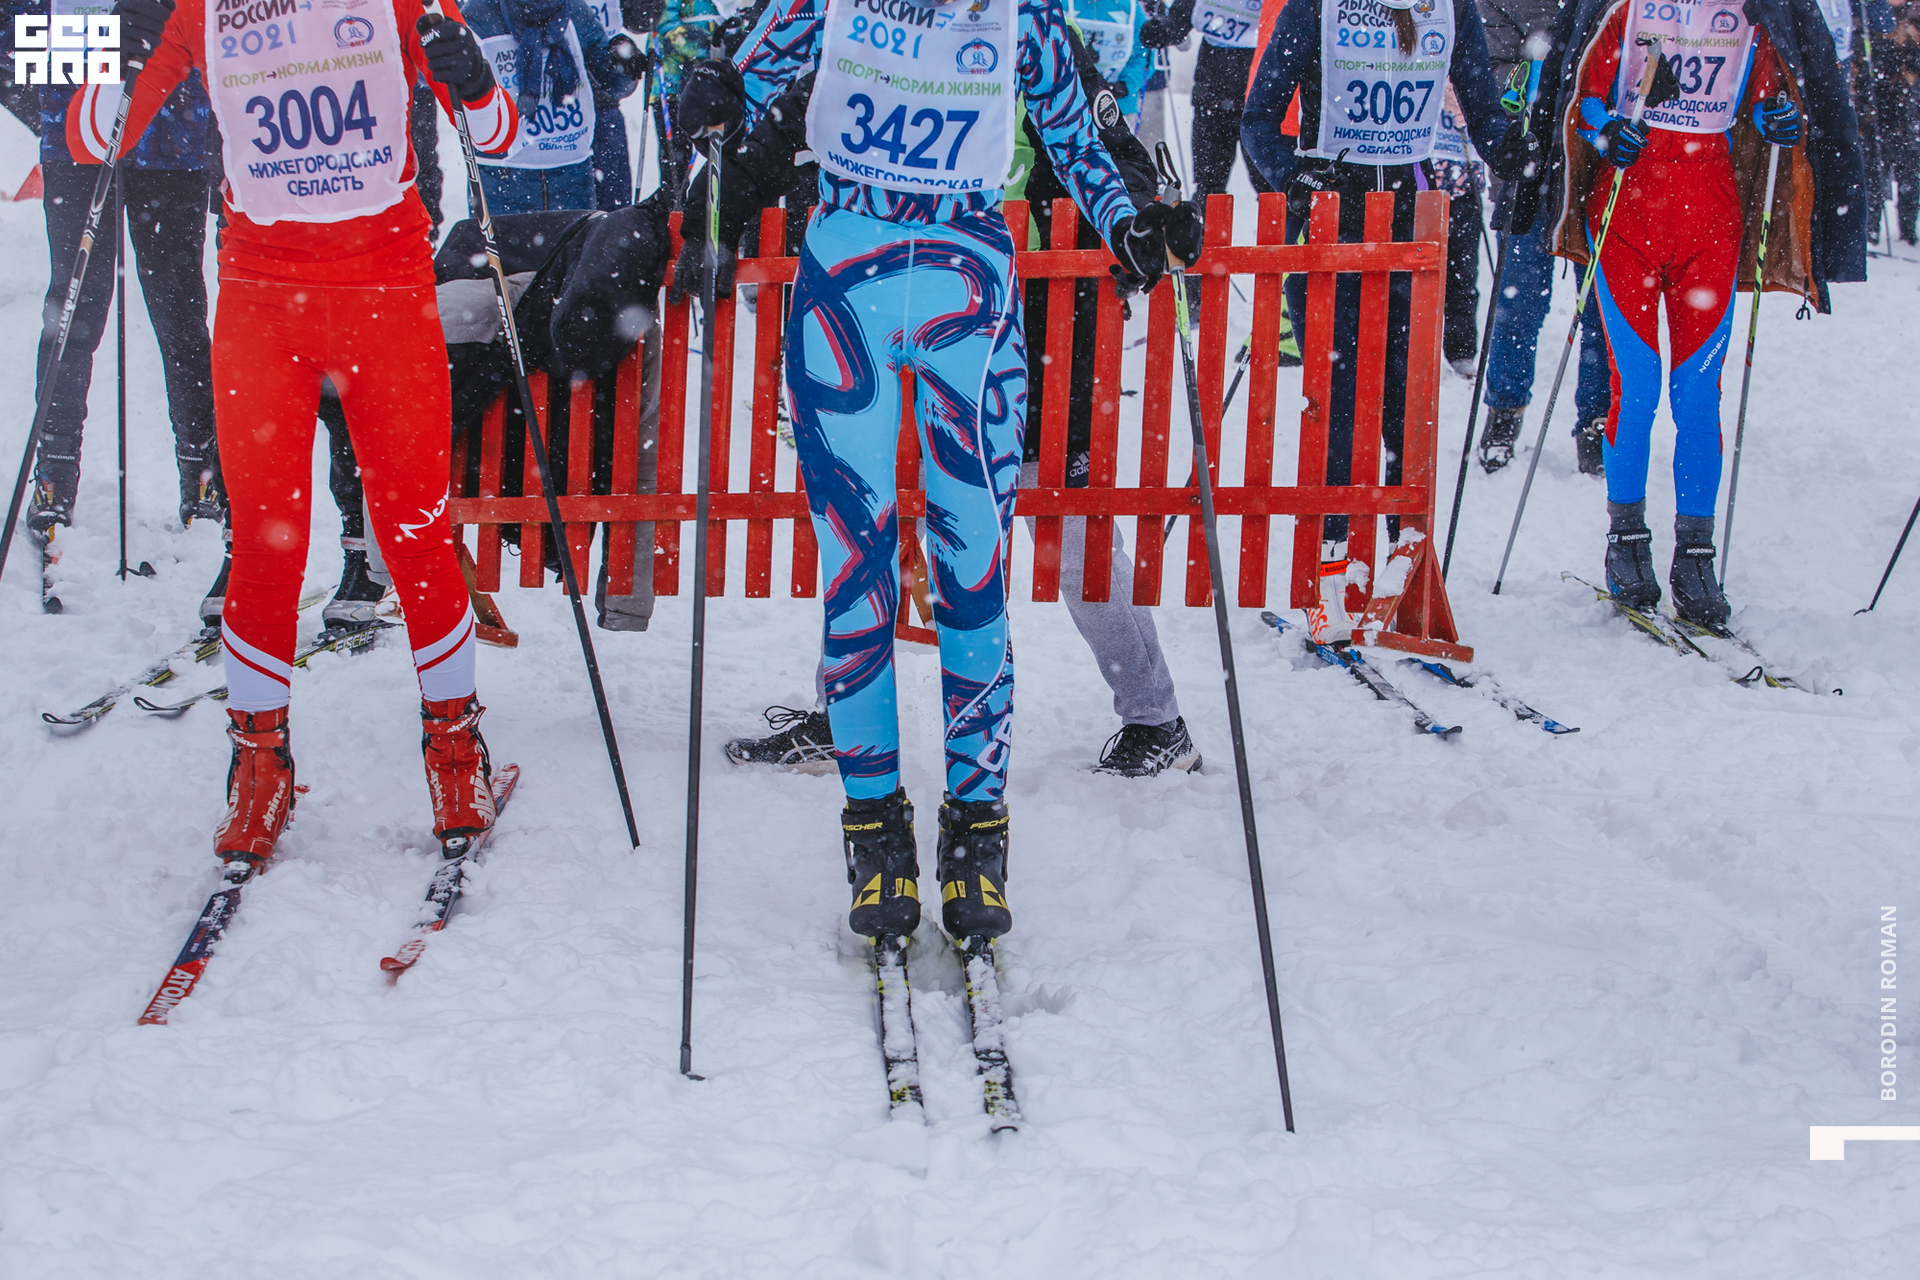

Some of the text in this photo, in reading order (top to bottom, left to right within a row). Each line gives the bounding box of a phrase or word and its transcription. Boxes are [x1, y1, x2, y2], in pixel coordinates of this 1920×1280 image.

[73, 6, 101, 16] СПОРТ
[218, 0, 297, 33] РОССИИ
[1337, 0, 1395, 21] ЛЫЖН
[220, 20, 296, 59] 2021
[847, 15, 923, 59] 2021
[1336, 27, 1396, 49] 2021
[1702, 38, 1740, 48] ЖИЗНИ
[495, 49, 518, 63] ЛЫЖ
[1334, 59, 1445, 72] СПОРТ НОРМА ЖИЗНИ
[222, 50, 385, 88] СПОРТ НОРМА ЖИЗНИ
[837, 57, 1001, 96] СПОРТ НОРМА ЖИЗНИ
[1636, 53, 1727, 96] 037
[1346, 79, 1435, 125] 3067
[1625, 90, 1728, 114] НИОРОДСКАЯ
[245, 79, 377, 155] 3004
[526, 98, 583, 137] 3058
[1643, 110, 1700, 128] ОБЛАСТЬ
[841, 93, 980, 171] 3427
[1333, 126, 1432, 144] НИЖЕГОРОДСКАЯ
[1357, 144, 1413, 155] ОБЛАСТЬ
[248, 145, 393, 178] НИЖЕГОРОДСКАЯ
[287, 175, 364, 197] ОБЛАСТЬ
[1699, 334, 1727, 374] NORDSKI
[1069, 463, 1090, 478] adi
[335, 630, 375, 653] FISCHE
[446, 713, 475, 734] alpina
[230, 732, 258, 748] alpina
[261, 781, 287, 832] alpina
[842, 821, 883, 831] FISCHER
[144, 968, 195, 1024] ATOMIC
